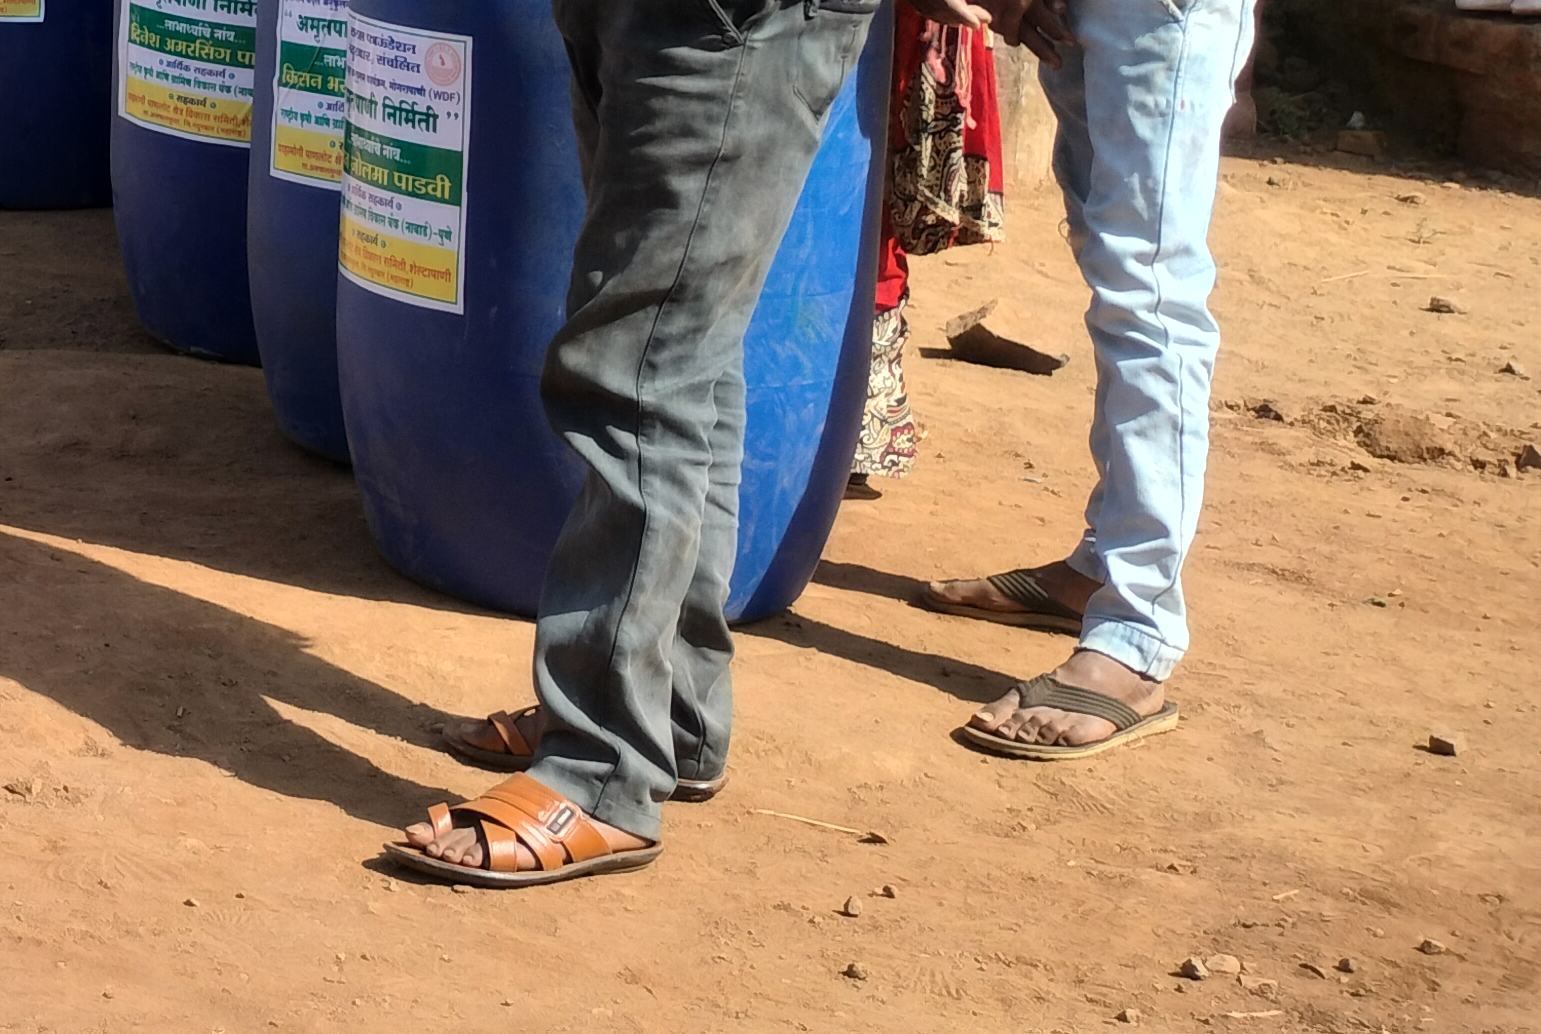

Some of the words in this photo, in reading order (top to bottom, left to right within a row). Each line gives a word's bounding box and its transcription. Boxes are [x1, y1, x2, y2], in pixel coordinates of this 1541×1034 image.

[297, 14, 348, 44] अमृतपा
[164, 38, 231, 63] अमरसिंग
[237, 51, 256, 66] पा
[376, 53, 421, 73] संचलित
[282, 63, 323, 90] किसन
[429, 88, 461, 105] (WDF)
[382, 96, 439, 133] निर्मिती
[393, 174, 452, 199] पाडवी
